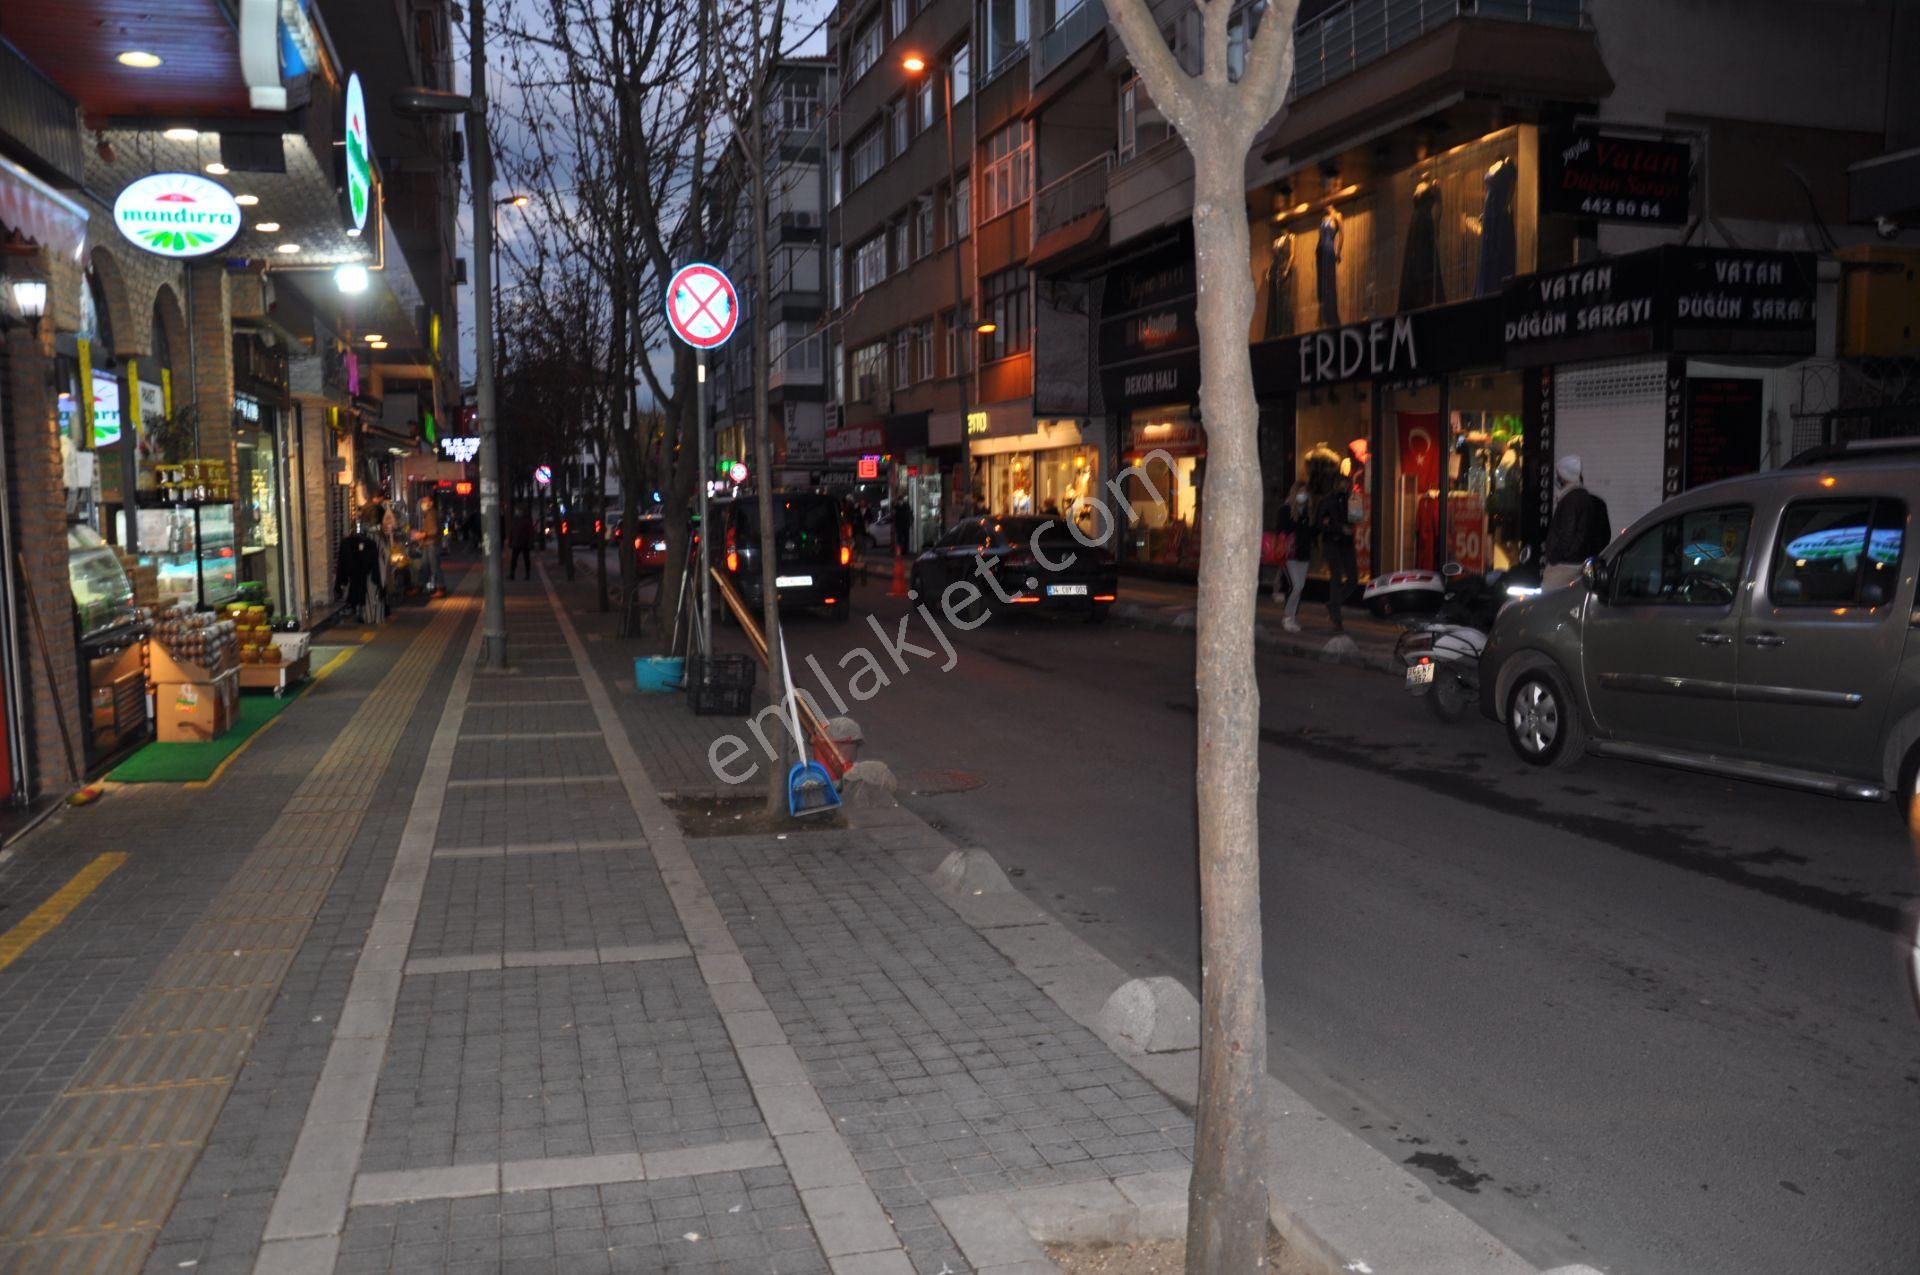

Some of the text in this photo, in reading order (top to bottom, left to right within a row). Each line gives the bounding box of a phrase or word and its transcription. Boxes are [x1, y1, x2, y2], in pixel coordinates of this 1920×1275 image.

[1581, 196, 1611, 215] 442
[1540, 266, 1612, 303] VATAN
[1714, 259, 1783, 286] VATAN
[1576, 297, 1652, 331] SARAYI
[1298, 314, 1417, 384] ERDEM
[1125, 372, 1153, 397] DEKOR
[1668, 377, 1681, 449] VATAN
[1455, 531, 1480, 559] 50
